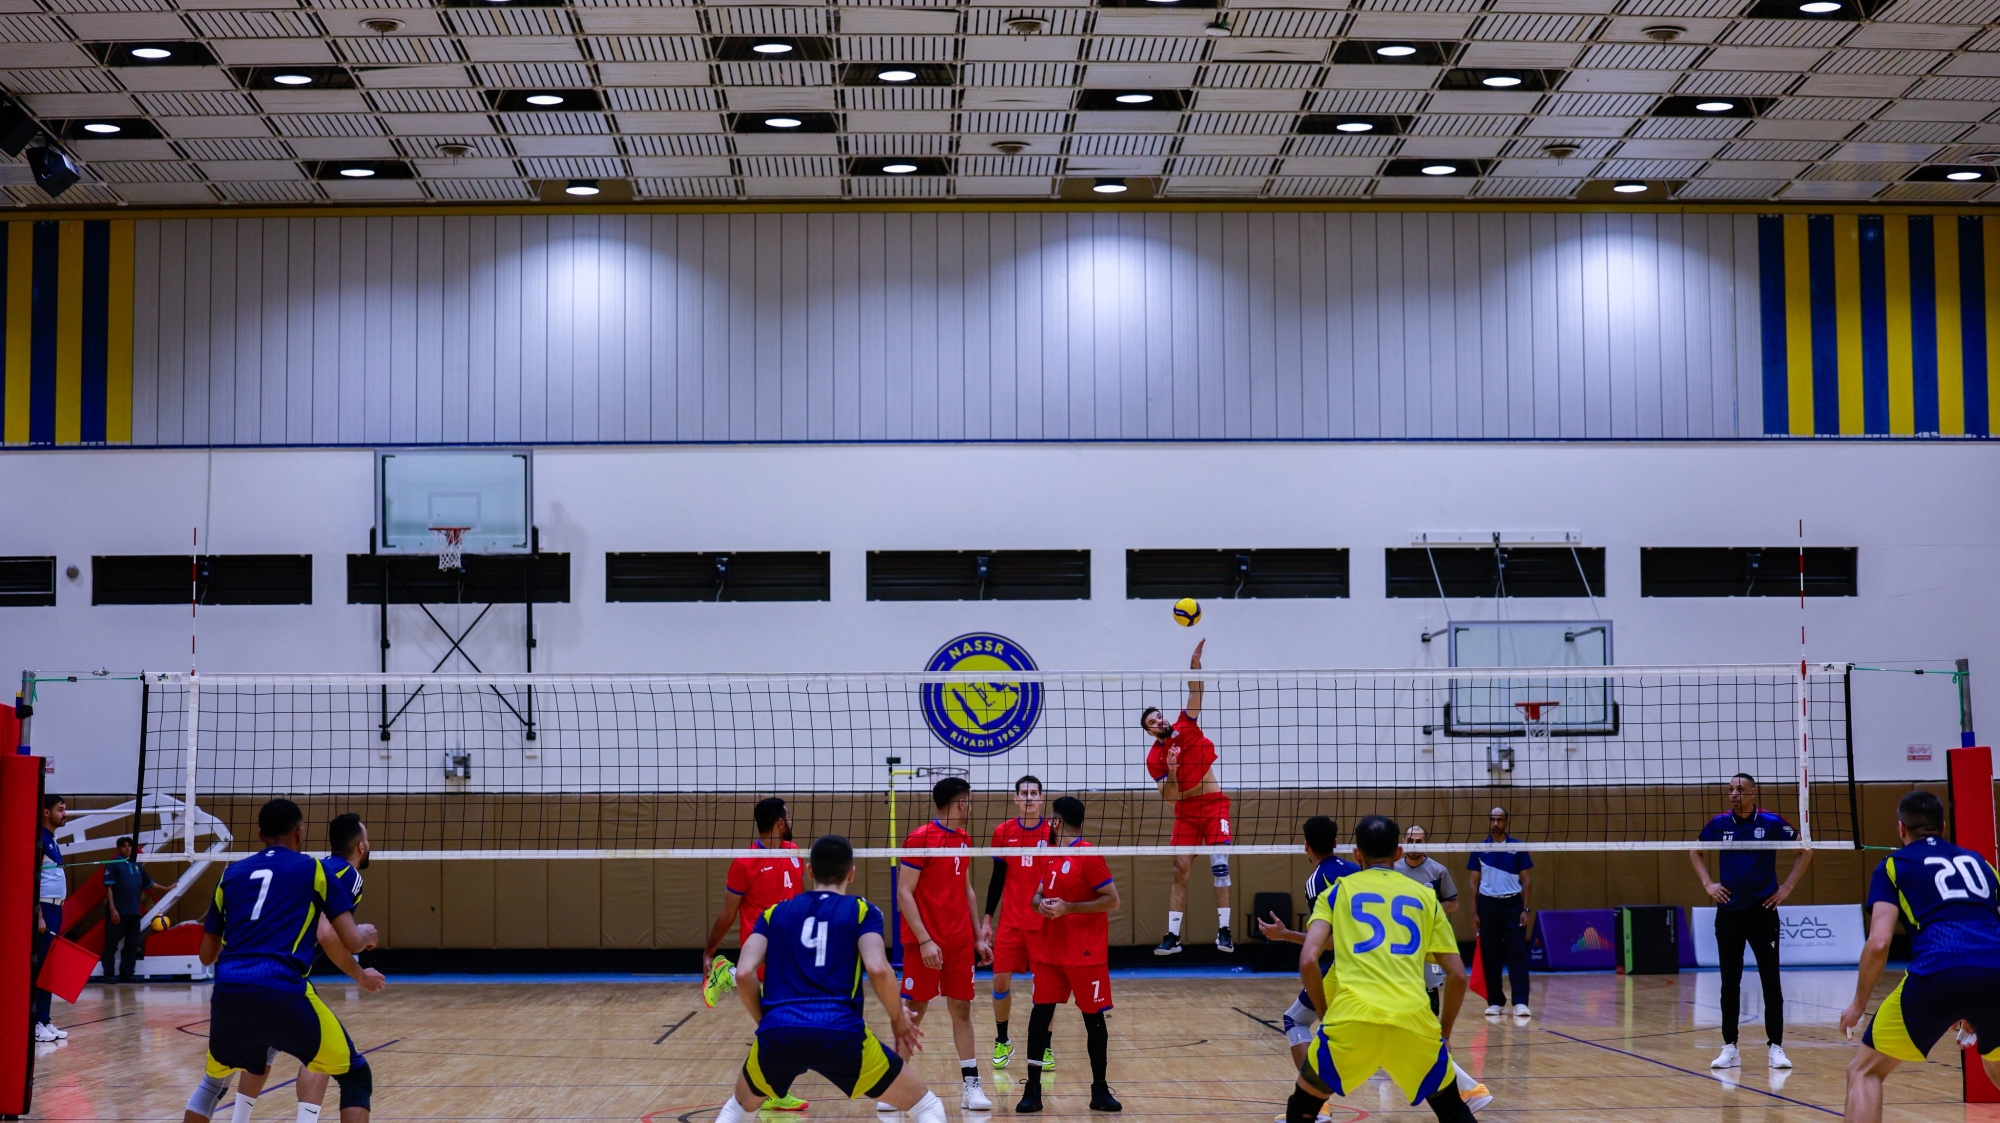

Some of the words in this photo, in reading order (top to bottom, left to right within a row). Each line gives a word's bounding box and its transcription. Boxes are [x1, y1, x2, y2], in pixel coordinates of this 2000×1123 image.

[948, 640, 1004, 660] NASSR
[950, 731, 994, 746] RIYADH
[1220, 818, 1229, 833] 15
[954, 856, 961, 875] 2
[783, 870, 793, 889] 4
[1048, 871, 1057, 890] 7
[1923, 855, 1990, 901] 20
[249, 868, 274, 921] 7
[1350, 892, 1424, 956] 55
[800, 915, 828, 967] 4
[1091, 980, 1100, 999] 7
